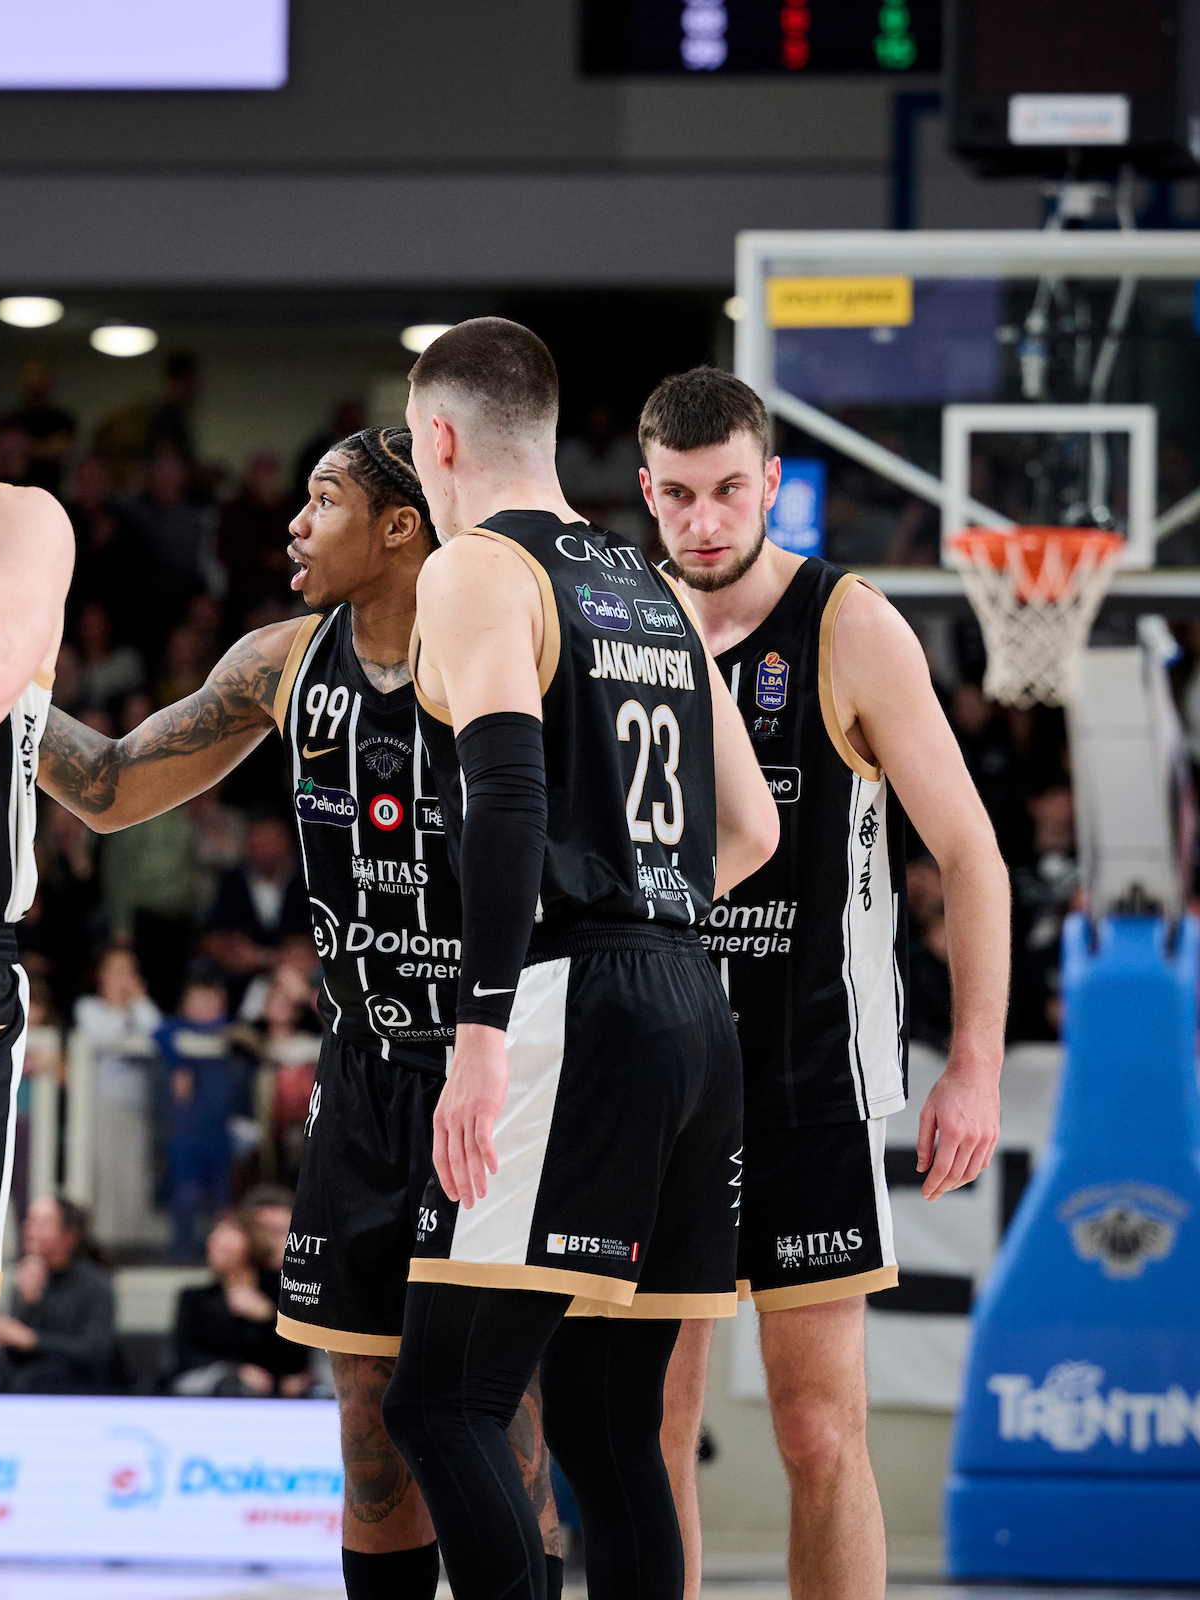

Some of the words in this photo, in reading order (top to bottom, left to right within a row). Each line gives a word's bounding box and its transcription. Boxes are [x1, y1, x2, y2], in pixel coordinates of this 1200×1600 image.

[555, 535, 643, 571] CAVIT
[601, 572, 637, 586] TRENTO
[582, 600, 629, 620] Melinda
[589, 638, 695, 691] JAKIMOVSKI
[761, 676, 783, 686] LBA
[762, 695, 781, 704] Unipol
[306, 683, 349, 739] 99
[357, 737, 381, 752] AQUILA
[384, 736, 412, 755] BASKET
[616, 699, 684, 845] 23
[296, 794, 354, 816] Melinda
[376, 860, 429, 885] ITAS
[653, 867, 688, 889] ITAS
[378, 883, 416, 895] MUTUA
[659, 890, 684, 901] MUTUA
[699, 901, 798, 929] omiti
[346, 922, 461, 960] Dolom
[700, 933, 792, 957] energia
[396, 962, 461, 979] ener
[285, 1232, 327, 1255] AVIT
[568, 1235, 600, 1253] BTS
[601, 1244, 630, 1252] TRENTINO
[807, 1228, 863, 1256] ITAS
[808, 1252, 851, 1266] MUTUA
[283, 1277, 321, 1295] Dolomiti
[290, 1294, 319, 1305] energia
